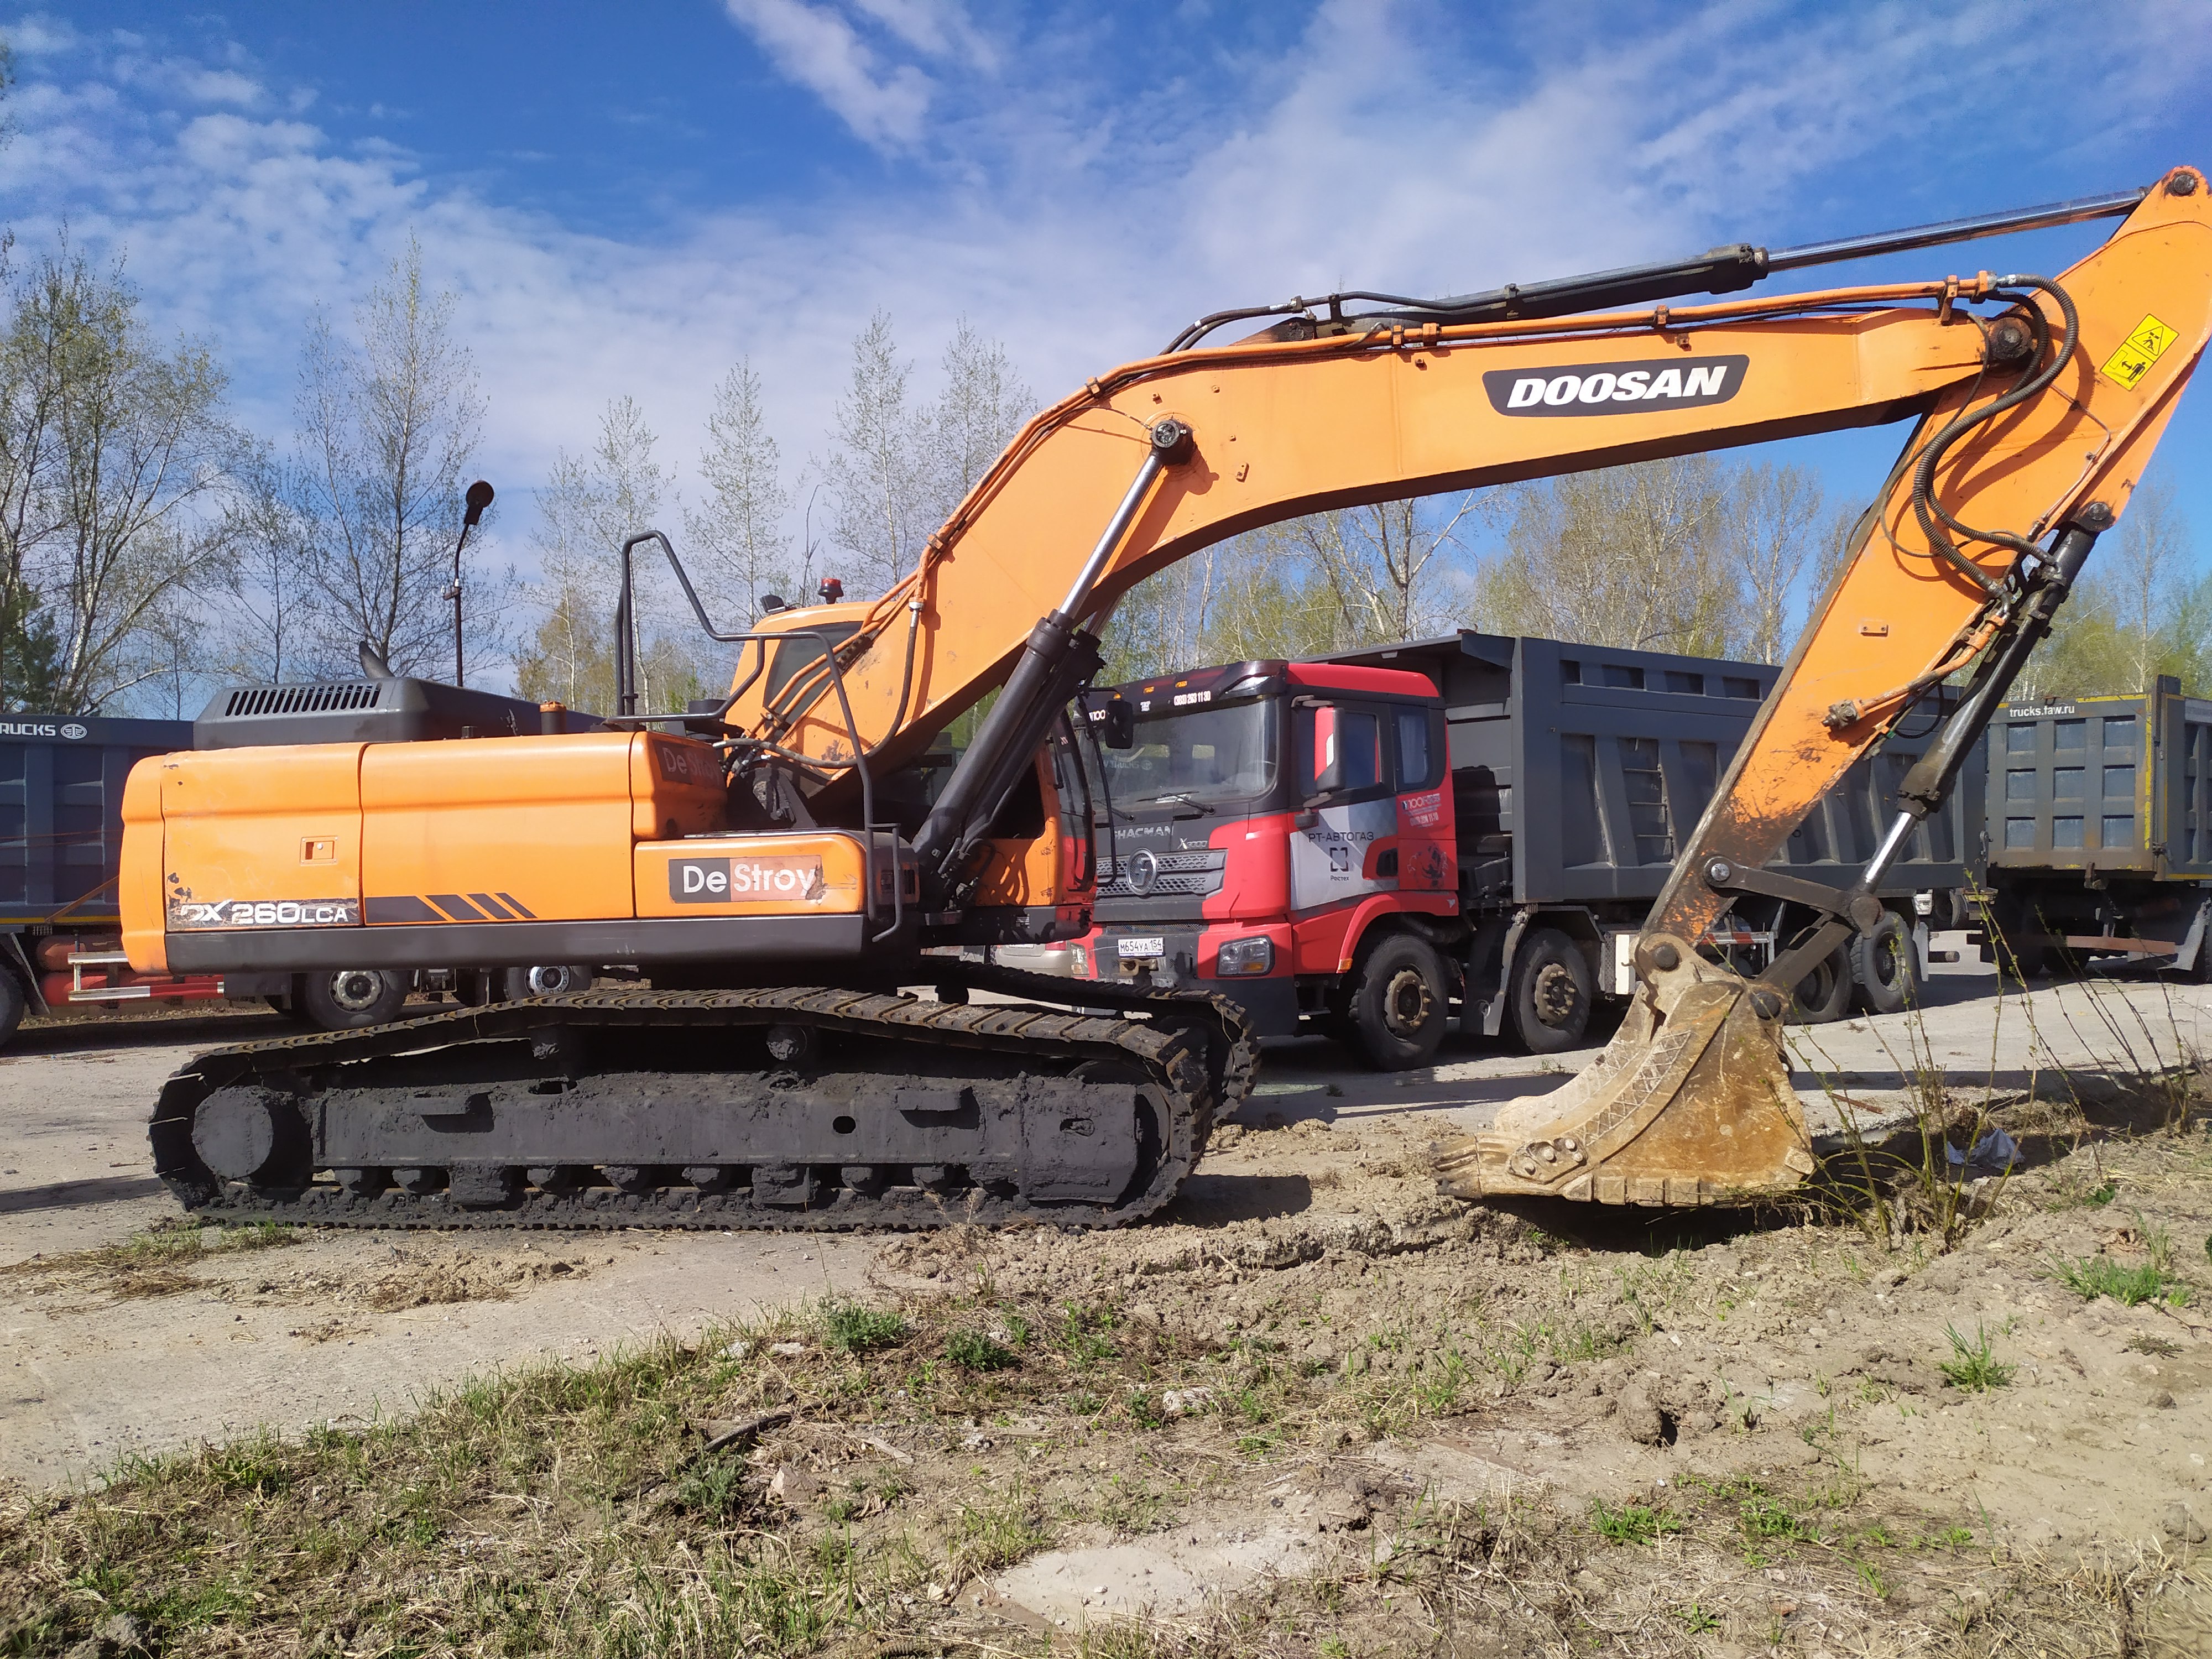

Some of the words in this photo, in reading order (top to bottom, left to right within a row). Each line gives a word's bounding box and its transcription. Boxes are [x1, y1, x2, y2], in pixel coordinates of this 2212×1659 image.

[1507, 366, 1727, 408] DOOSAN
[2010, 706, 2075, 717] trucks.faw.ru
[662, 747, 687, 774] De
[1308, 832, 1374, 842] РТ-АВТОГАЗ
[683, 865, 727, 893] De
[734, 864, 815, 896] Stroy
[1120, 941, 1149, 952] М654УА
[1150, 940, 1161, 950] 154
